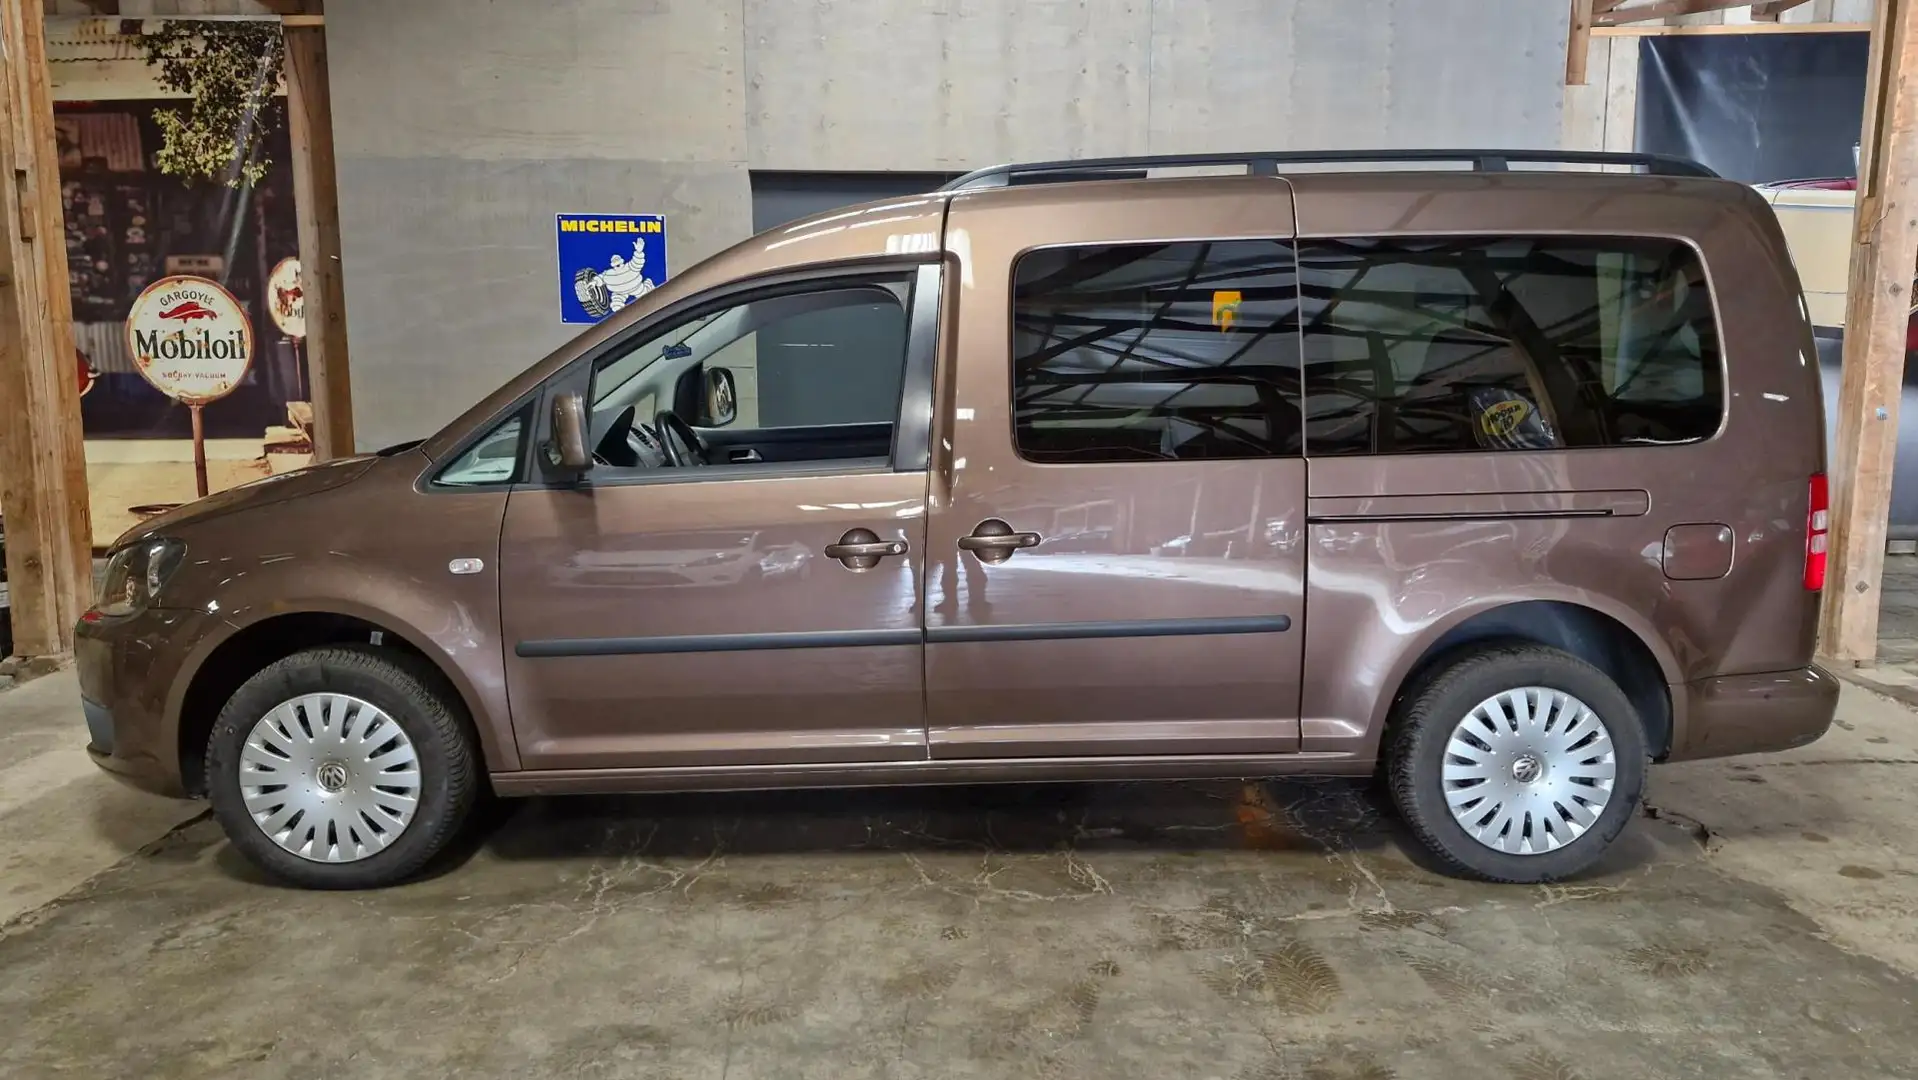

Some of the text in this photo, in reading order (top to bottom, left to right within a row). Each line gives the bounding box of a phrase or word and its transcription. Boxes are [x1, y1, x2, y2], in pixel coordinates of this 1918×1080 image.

[561, 220, 661, 232] MICHELIN
[159, 290, 215, 306] GARGOYLE
[135, 329, 246, 360] Mobiloil
